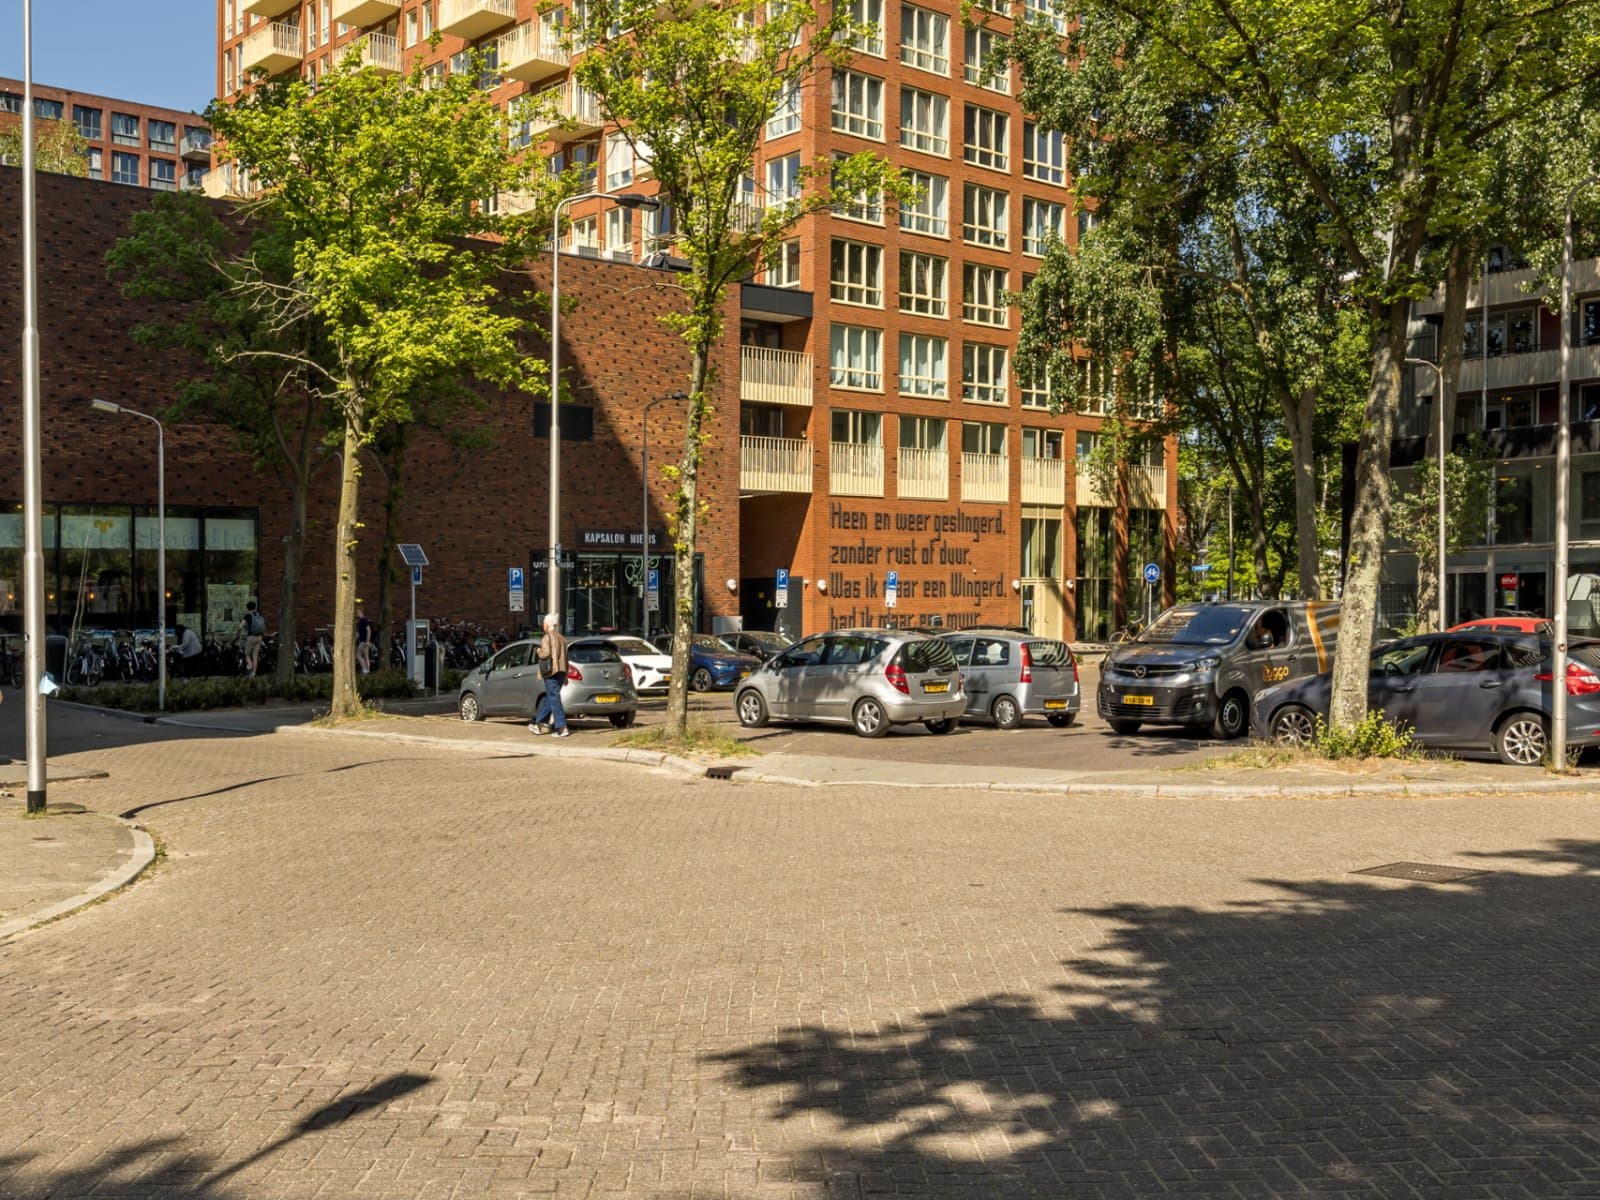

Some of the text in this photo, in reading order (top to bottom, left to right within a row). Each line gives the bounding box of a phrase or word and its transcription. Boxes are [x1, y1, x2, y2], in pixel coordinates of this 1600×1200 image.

[831, 502, 867, 529] Heen
[874, 512, 890, 530] en
[896, 512, 931, 531] weer
[584, 532, 625, 544] KAPSALON
[831, 538, 882, 564] zonder
[886, 539, 917, 564] rust
[921, 539, 936, 564] of
[512, 569, 520, 581] P
[649, 571, 656, 582] P
[831, 572, 861, 598] Was
[865, 572, 877, 598] ik
[883, 580, 918, 598] aar
[923, 580, 946, 598] een
[831, 607, 856, 630] had
[861, 607, 873, 628] ik
